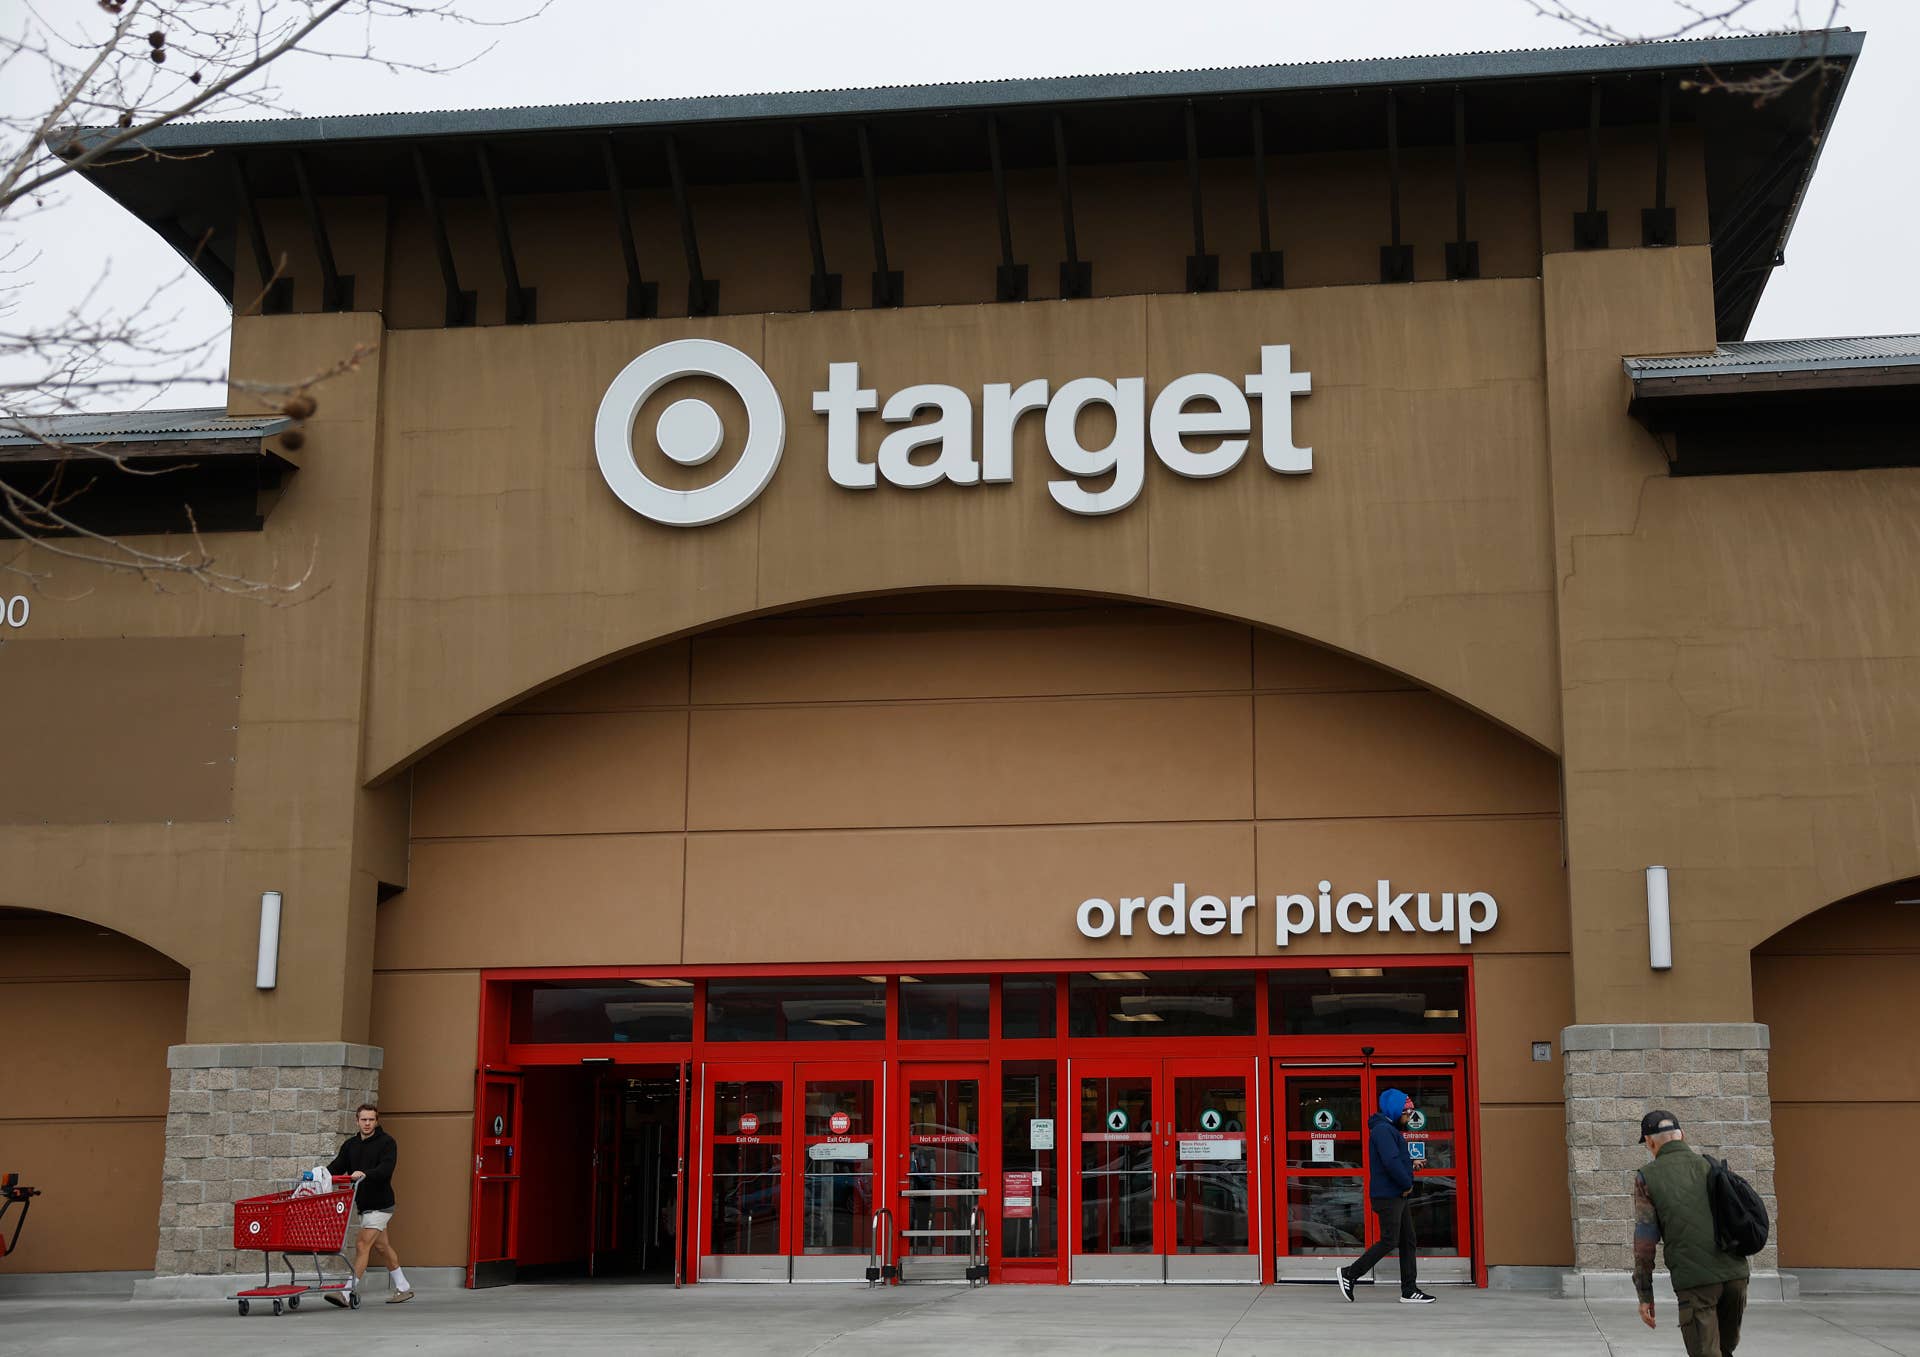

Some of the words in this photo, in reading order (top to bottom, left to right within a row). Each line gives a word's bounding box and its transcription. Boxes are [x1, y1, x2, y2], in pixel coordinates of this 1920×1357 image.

[812, 343, 1314, 514] target
[0, 595, 30, 627] 0
[1076, 882, 1257, 938] order
[1275, 879, 1499, 946] pickup
[747, 1136, 760, 1144] Only
[838, 1136, 851, 1144] Only
